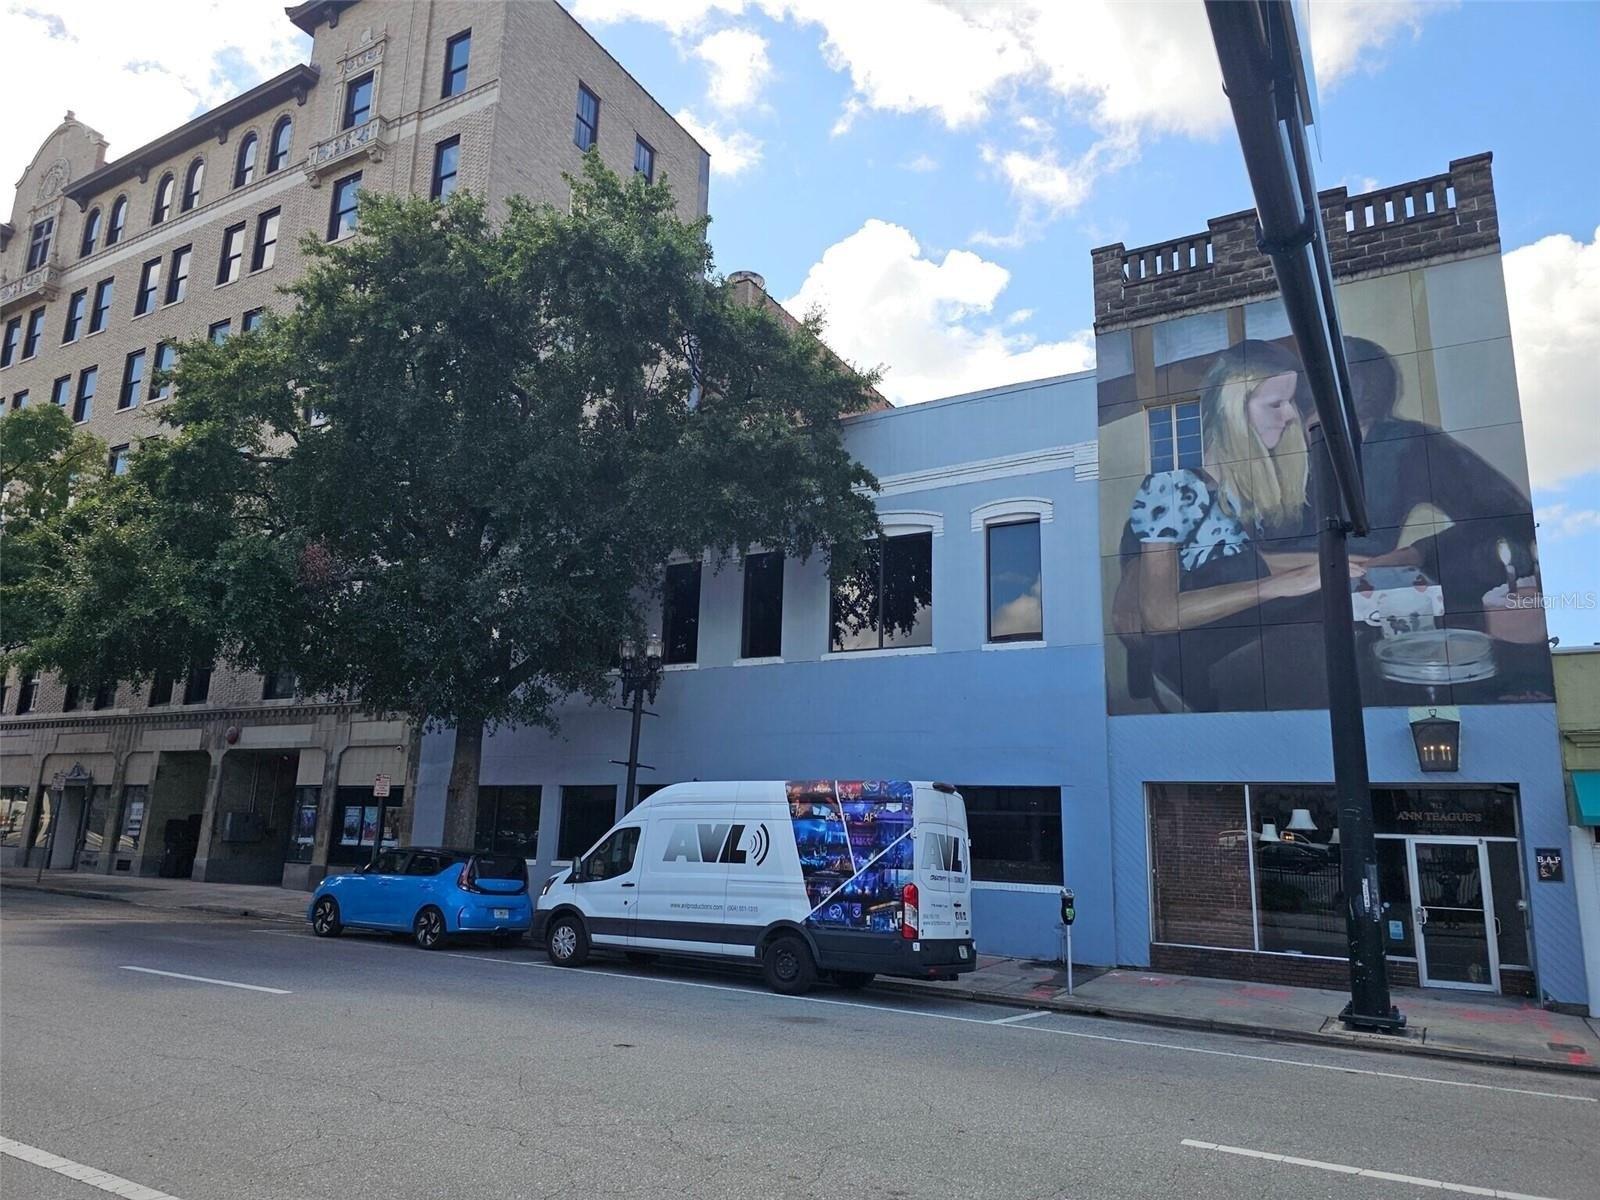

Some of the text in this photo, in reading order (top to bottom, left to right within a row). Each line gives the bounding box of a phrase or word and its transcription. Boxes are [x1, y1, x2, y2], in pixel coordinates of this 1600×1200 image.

[1397, 810, 1483, 823] ANN TEAGUE'S
[662, 823, 747, 864] AVL
[920, 831, 963, 873] AVL
